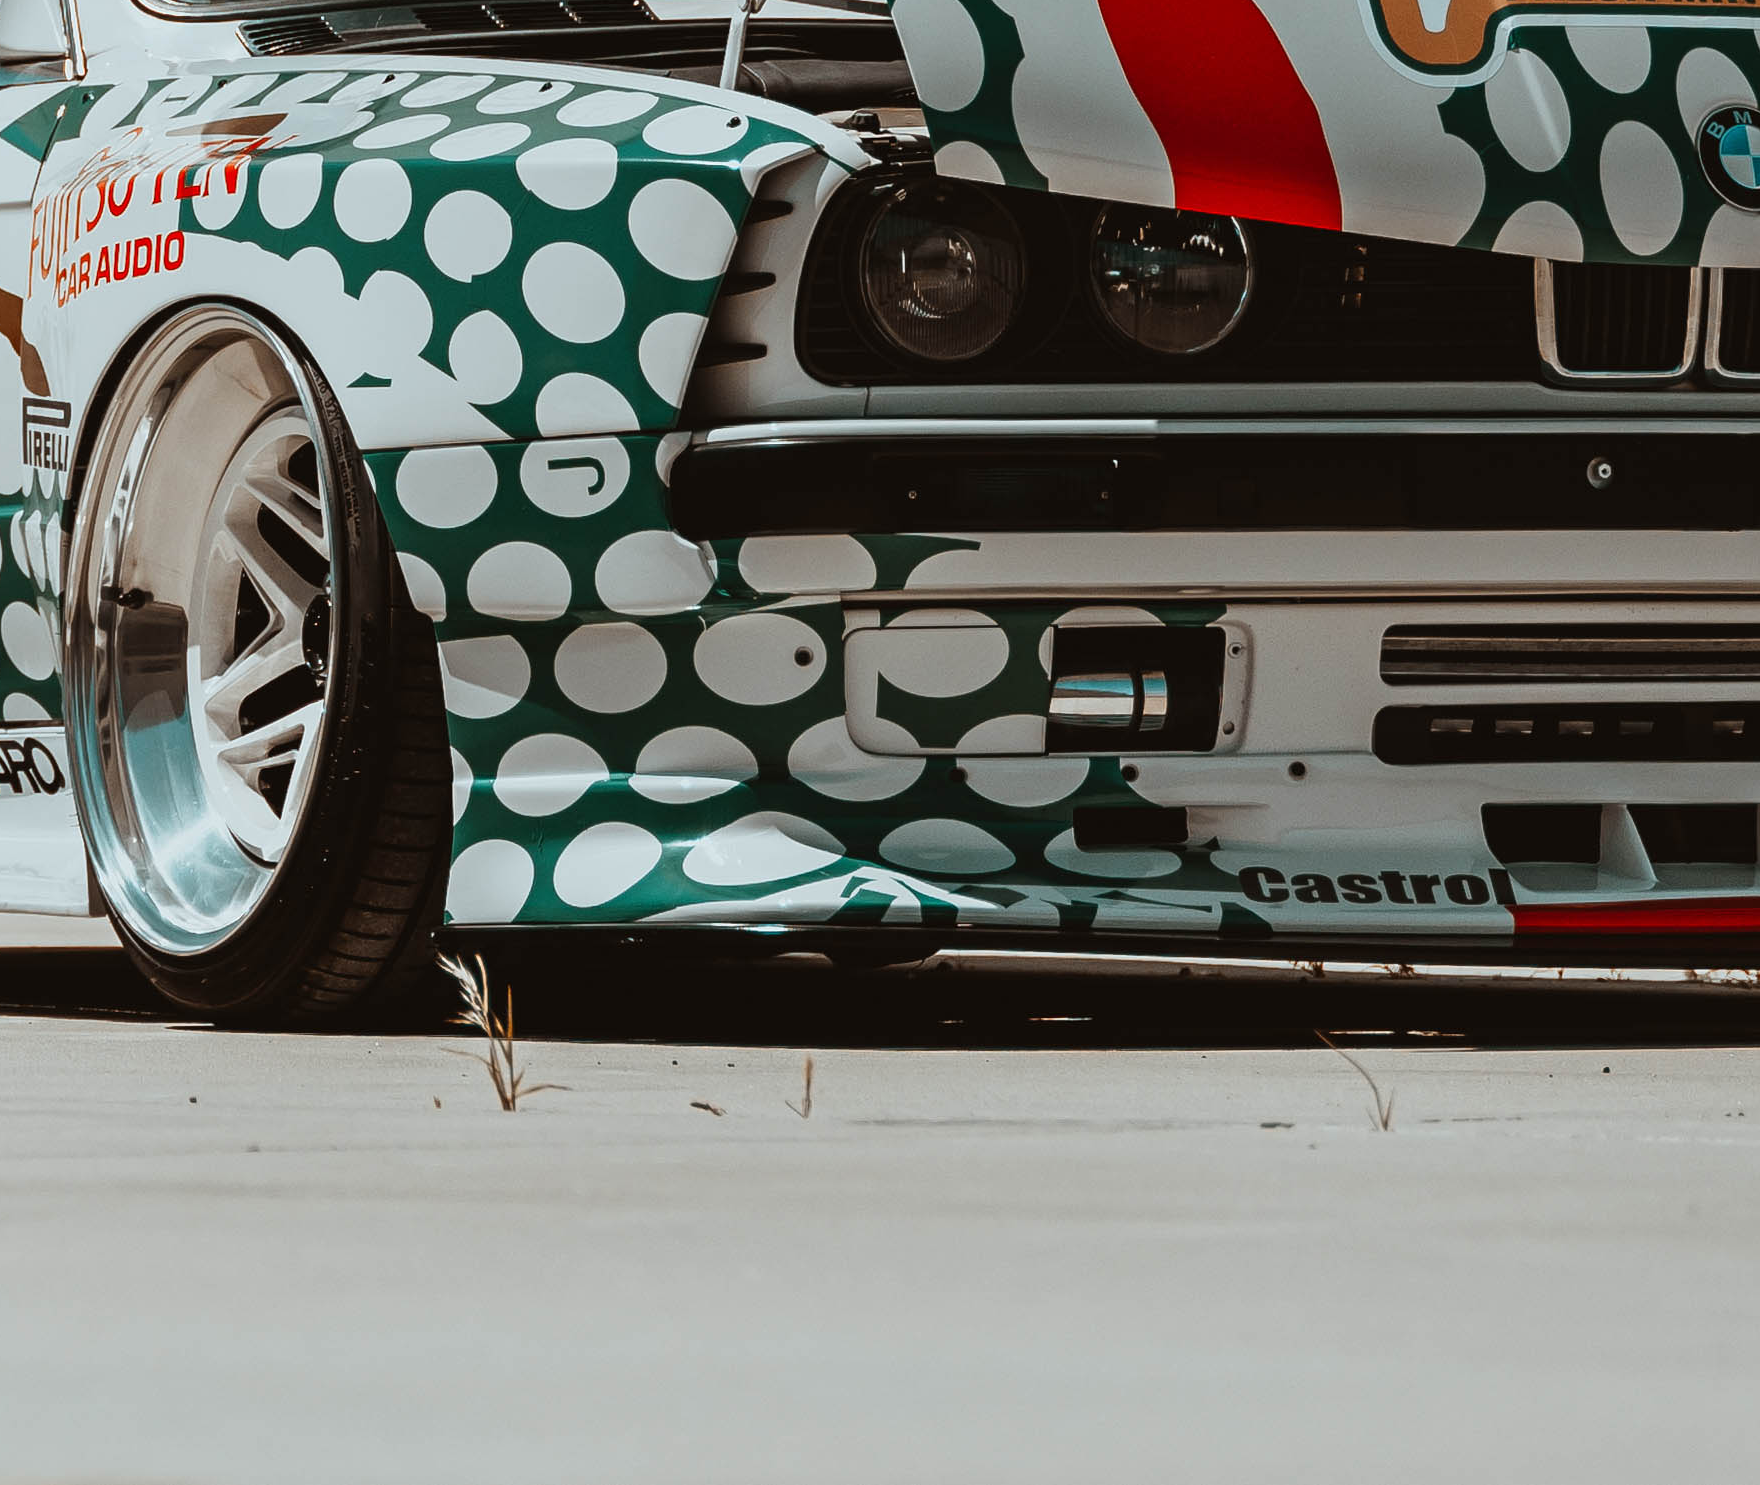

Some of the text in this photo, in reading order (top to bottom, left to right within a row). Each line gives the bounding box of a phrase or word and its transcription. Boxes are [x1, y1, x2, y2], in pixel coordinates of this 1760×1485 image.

[56, 230, 185, 308] CAR AUDIO
[22, 397, 71, 472] PIRELLI
[1238, 866, 1517, 905] Castrol
